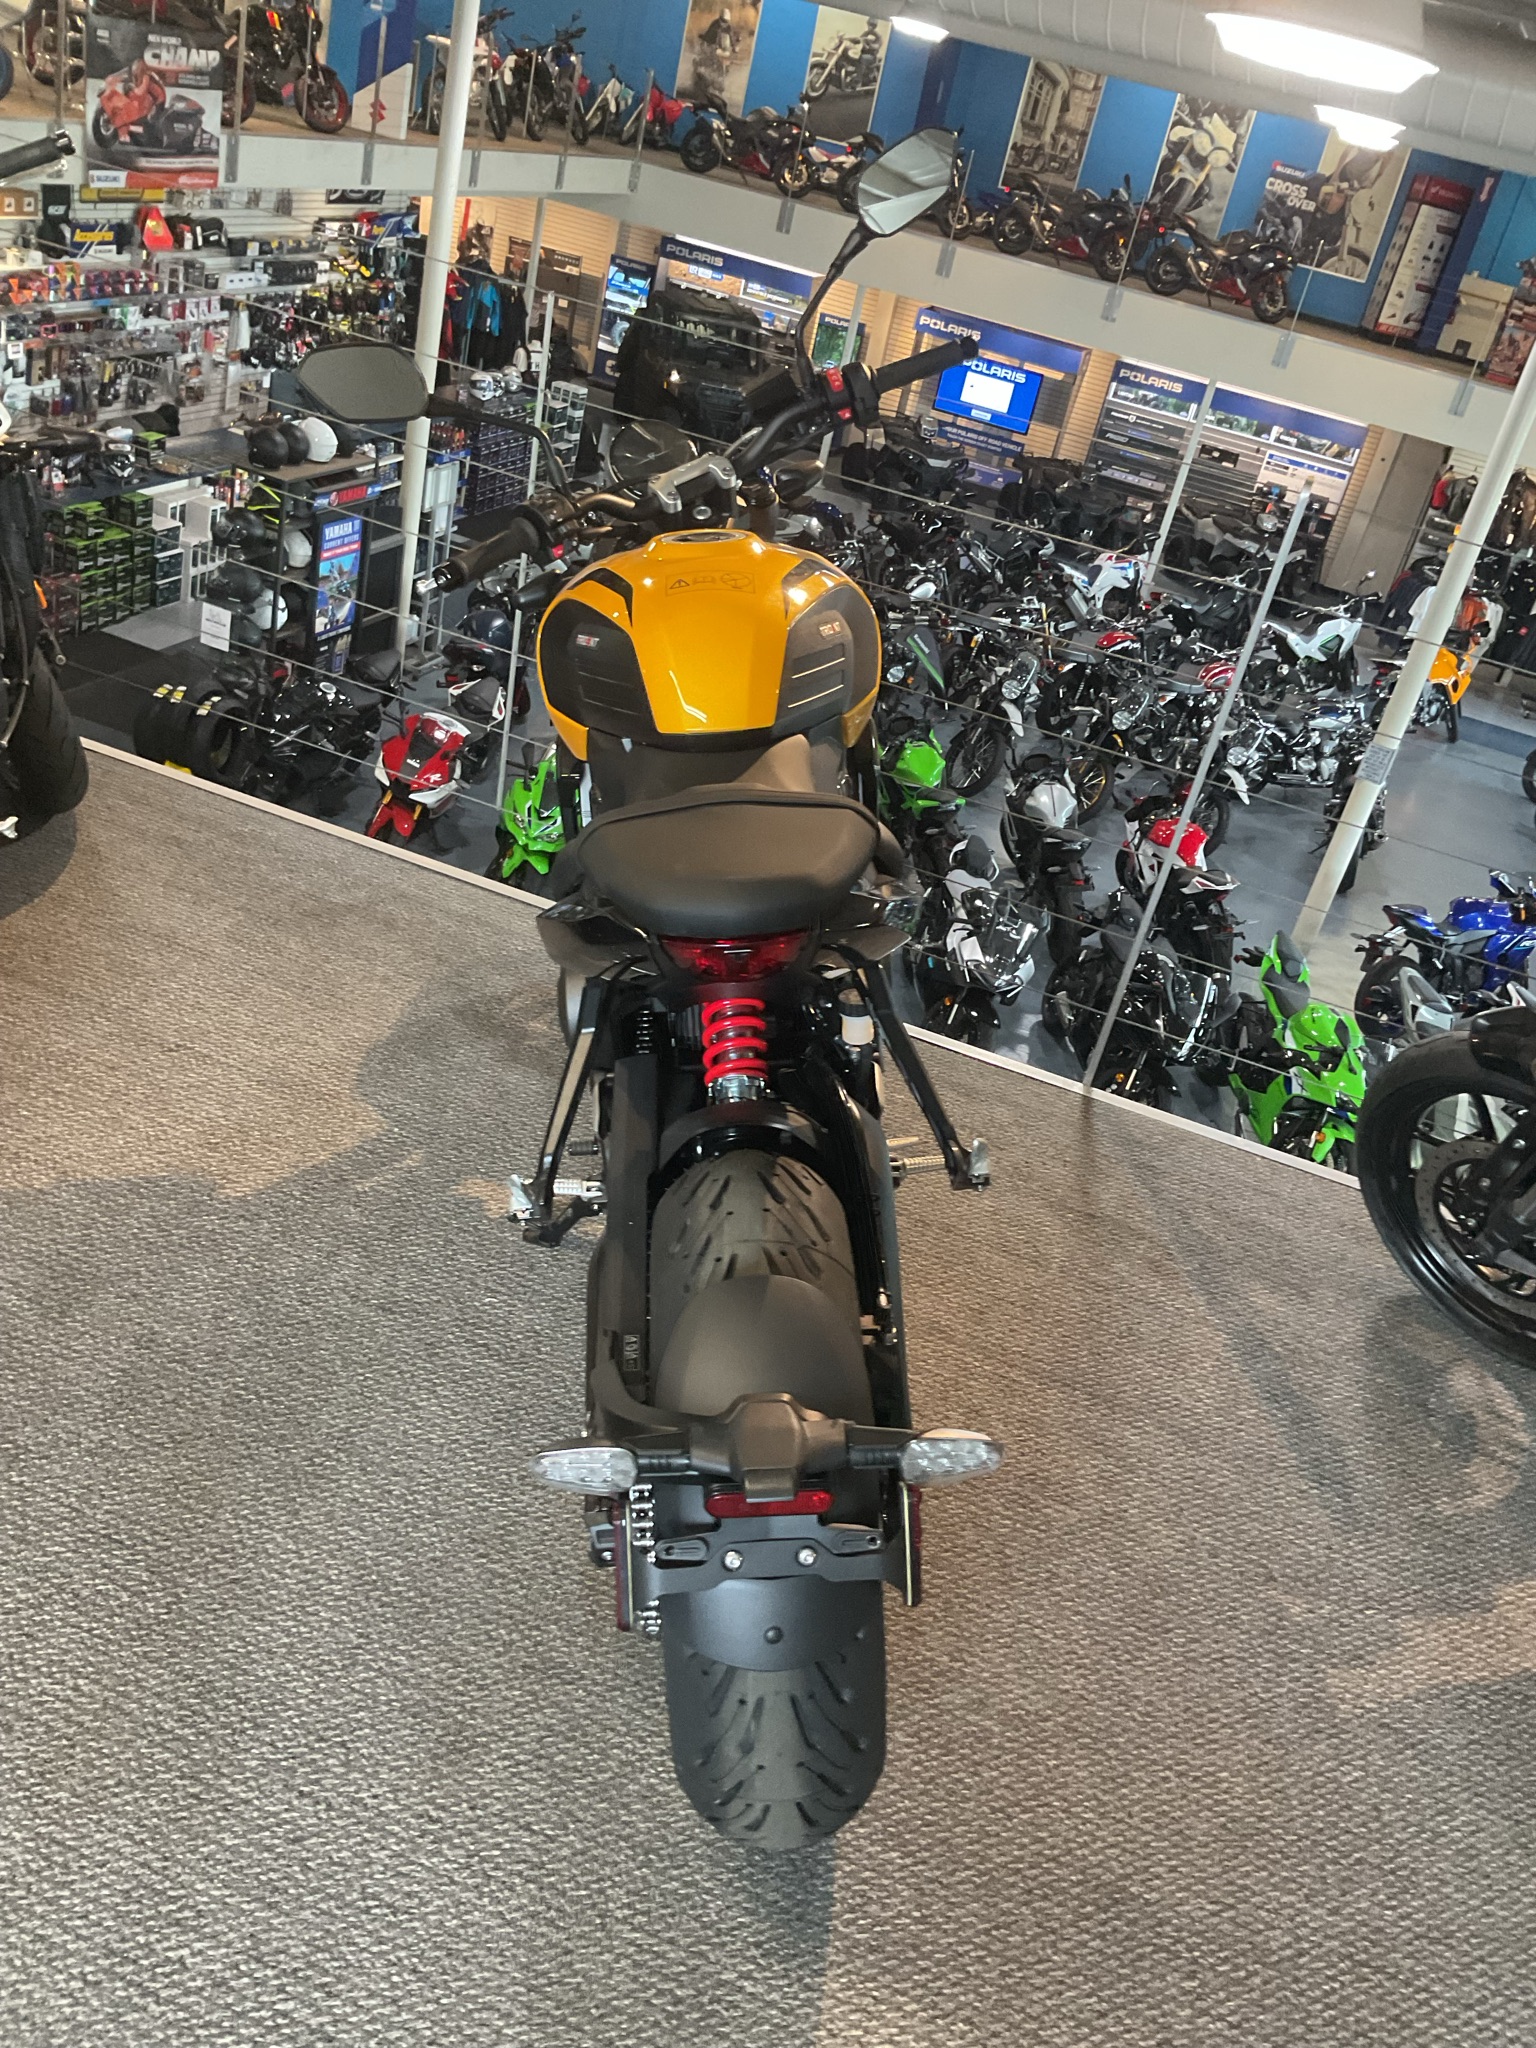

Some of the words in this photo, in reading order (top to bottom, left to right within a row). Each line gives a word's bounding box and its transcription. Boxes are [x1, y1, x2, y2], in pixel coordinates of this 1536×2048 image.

[144, 44, 220, 71] CHAMP
[1276, 165, 1305, 179] SUZUKI
[1265, 177, 1309, 199] CROSS
[1287, 196, 1316, 212] OVER
[666, 243, 724, 267] POLARIS
[1119, 368, 1183, 393] POLARIS
[325, 521, 353, 541] YAMAHA
